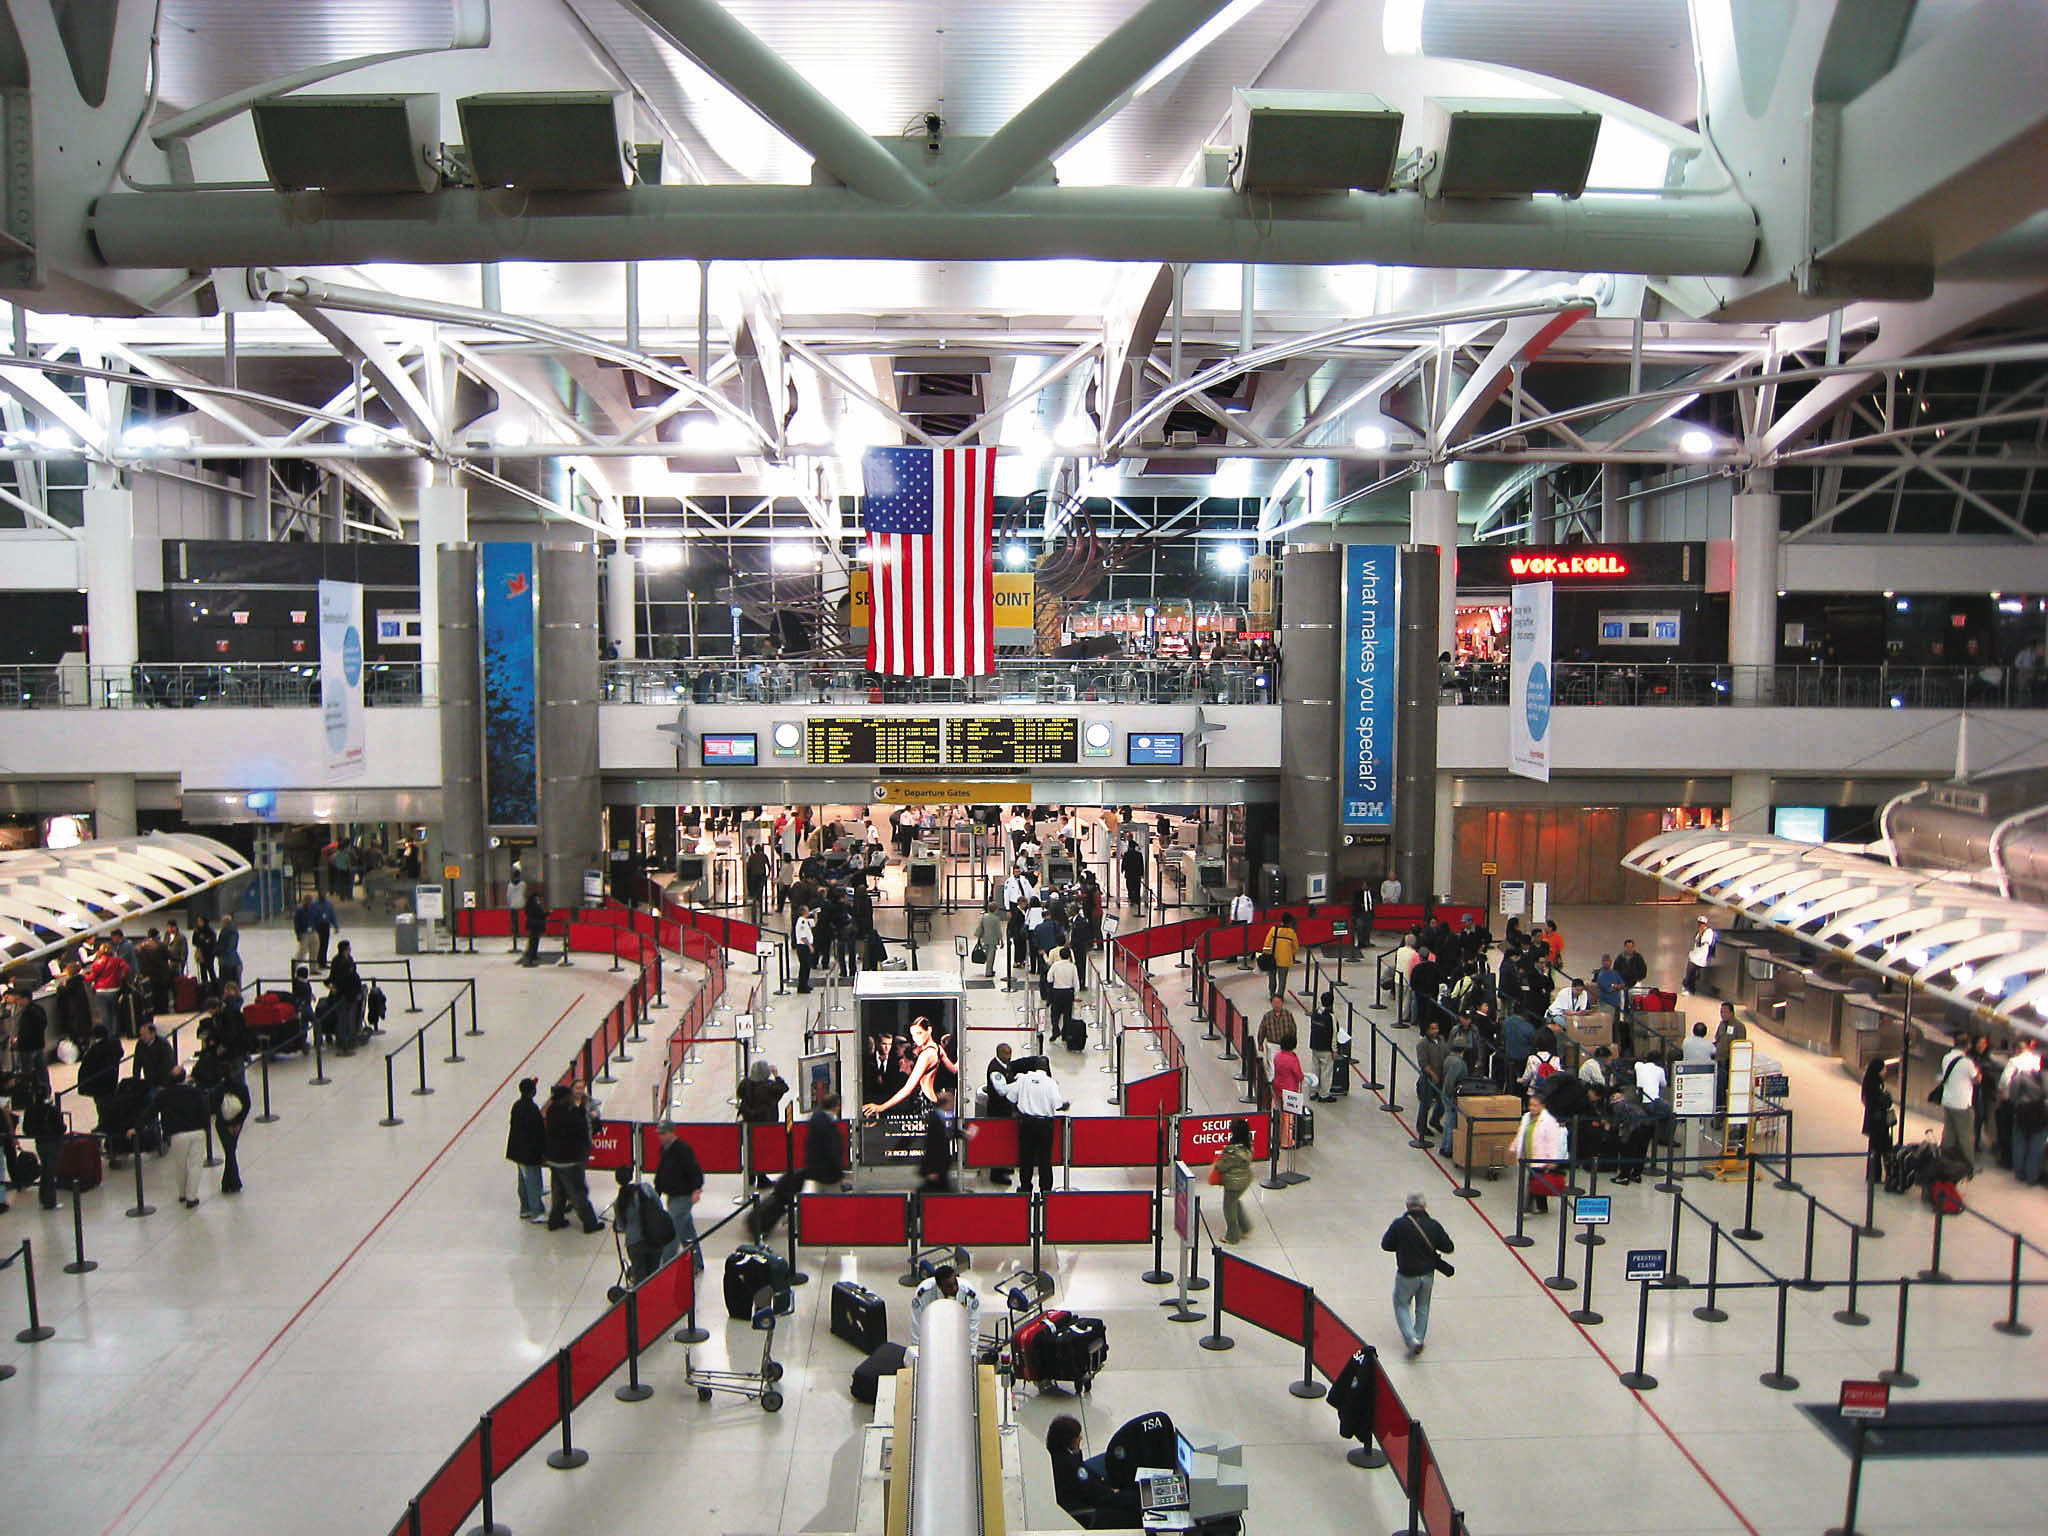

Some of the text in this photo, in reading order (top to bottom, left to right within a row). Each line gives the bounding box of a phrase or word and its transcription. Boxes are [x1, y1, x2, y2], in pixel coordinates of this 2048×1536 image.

[1510, 557, 1557, 574] WOK
[1355, 560, 1380, 792] what makes you special?
[904, 789, 971, 799] Departure Gates
[1349, 802, 1384, 817] IBM
[975, 826, 983, 834] 2
[1192, 1130, 1257, 1145] CHECK-PT
[1141, 1416, 1163, 1432] TSA
